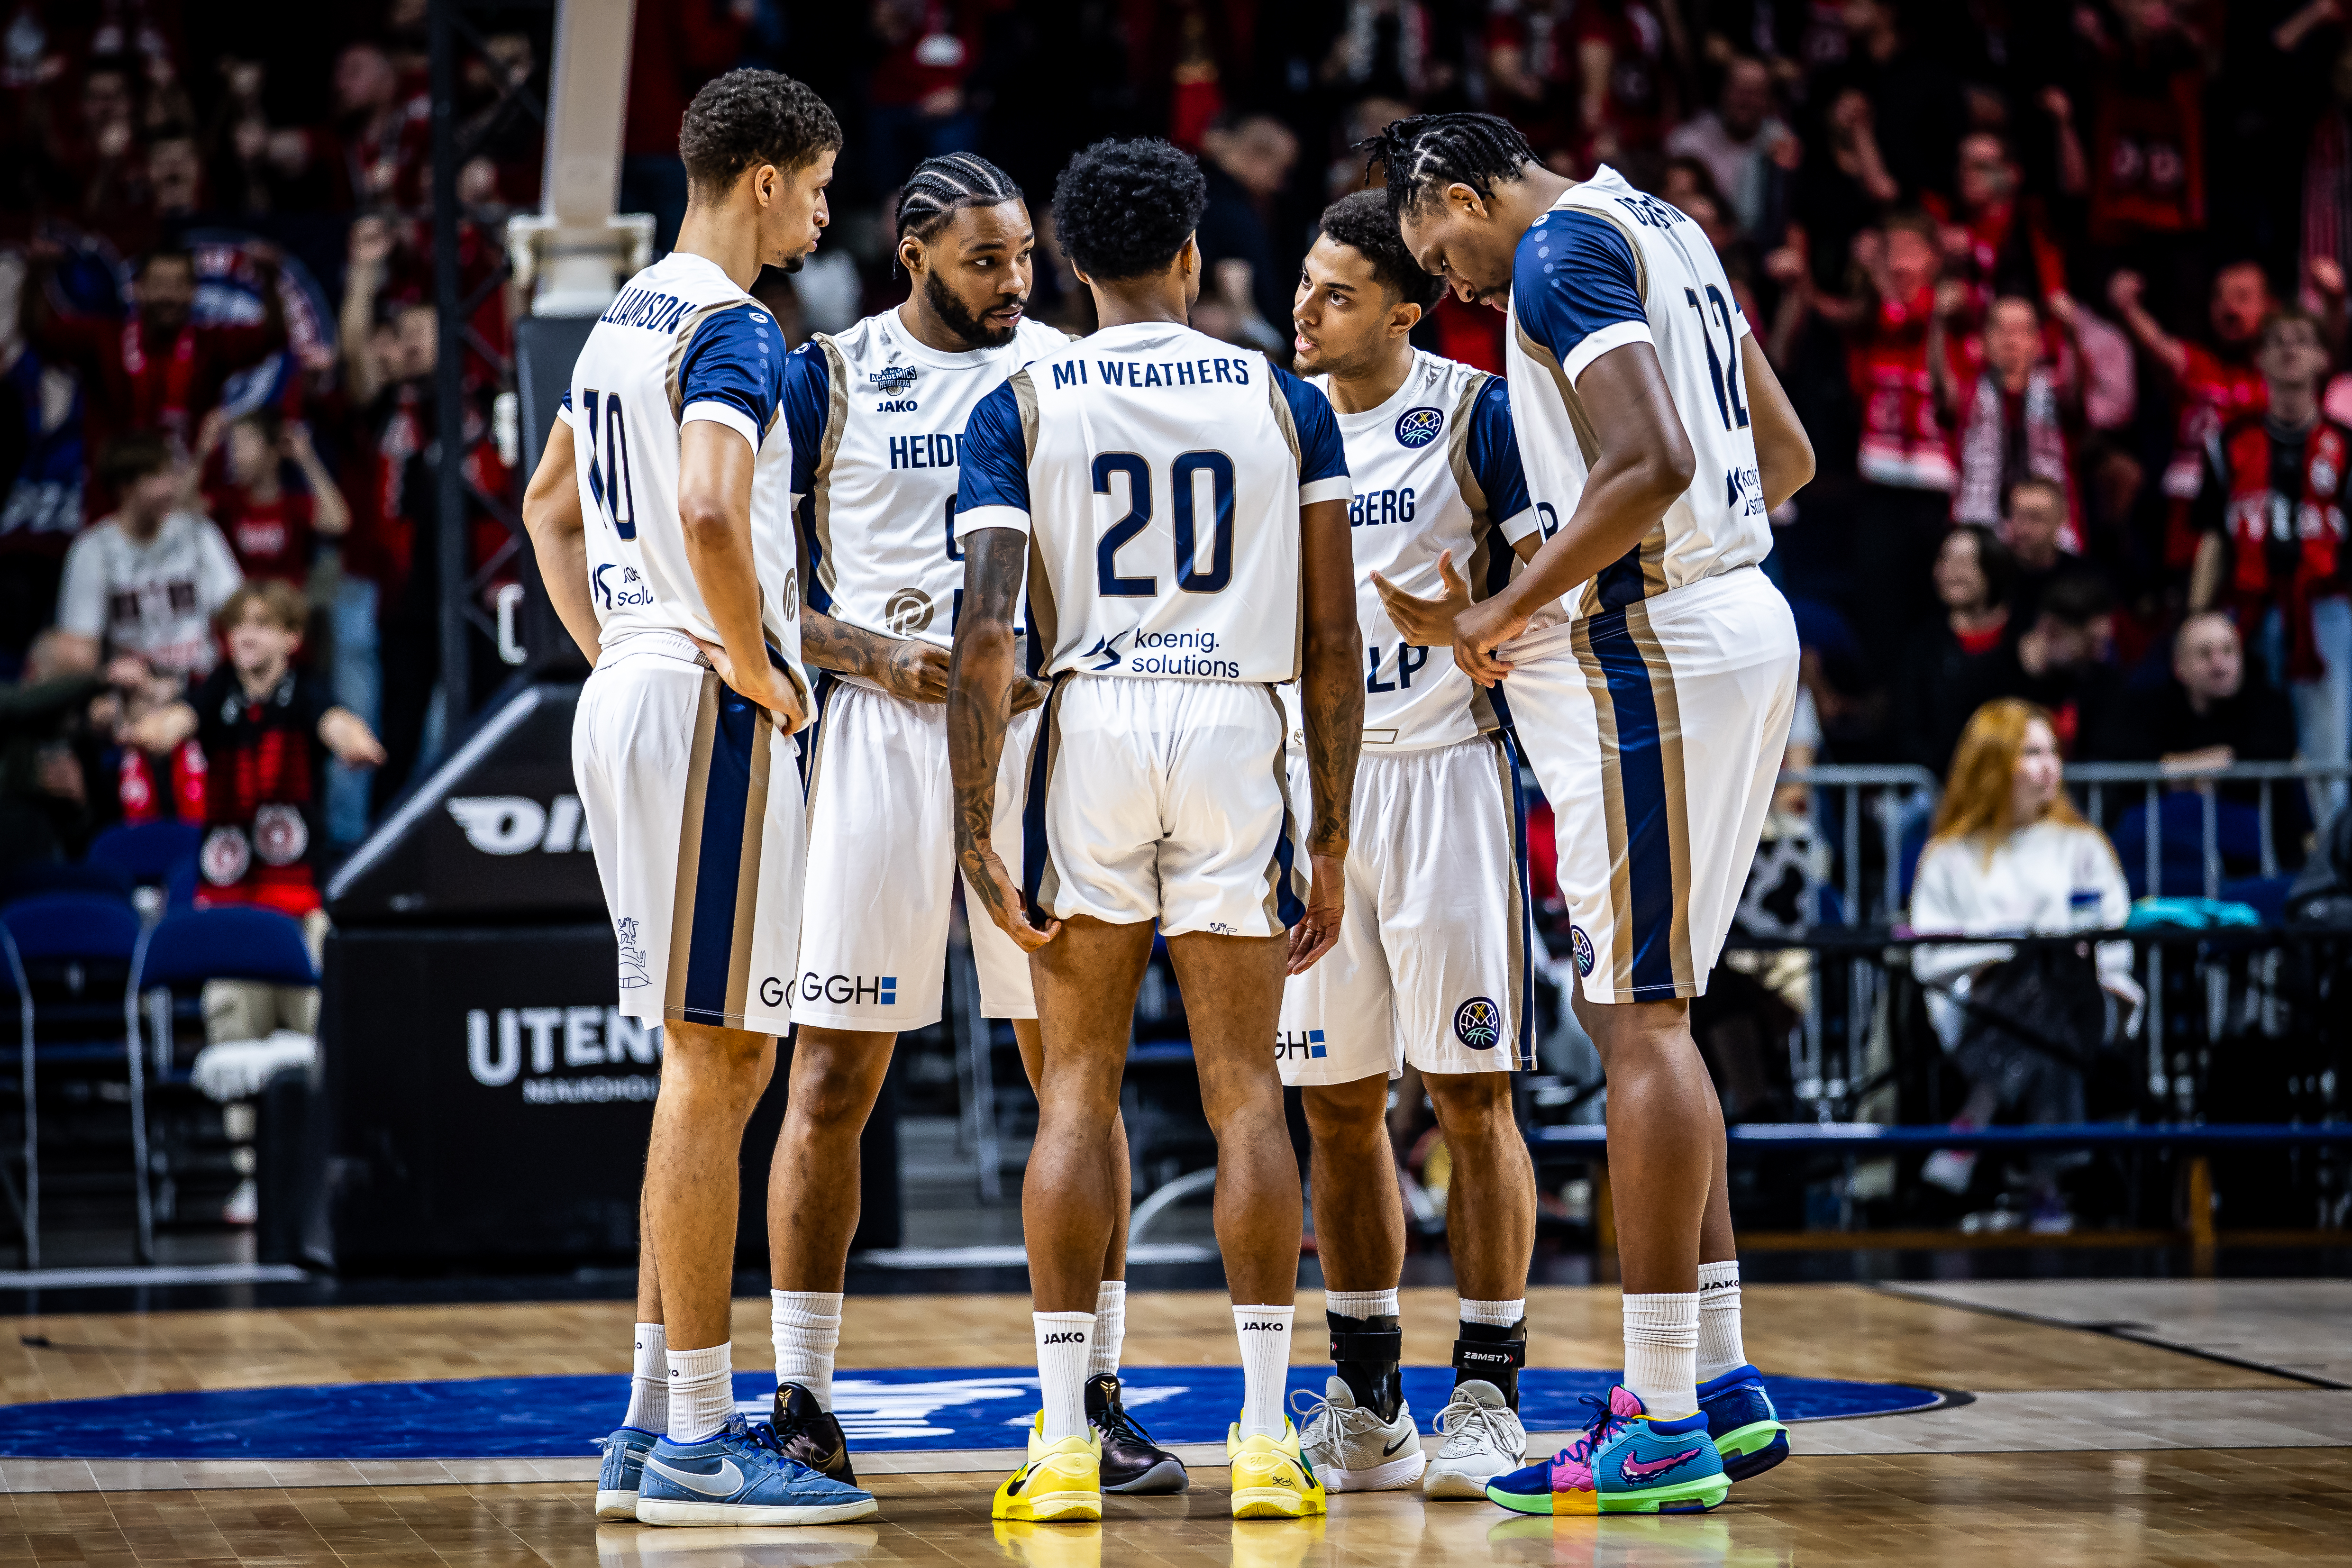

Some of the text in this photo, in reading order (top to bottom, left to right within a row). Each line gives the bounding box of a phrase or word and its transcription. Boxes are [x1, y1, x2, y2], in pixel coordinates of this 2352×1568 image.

[1684, 283, 1749, 432] 12
[871, 367, 915, 382] ACADEMICS
[879, 380, 910, 389] HEIDELBERG
[1052, 358, 1249, 390] MI WEATHERS
[877, 400, 918, 412] JAKO
[583, 388, 637, 541] 10
[1349, 487, 1415, 527] BERG
[1091, 449, 1236, 597] 20
[1134, 628, 1220, 653] koenig.
[1131, 655, 1240, 678] solutions
[802, 972, 880, 1004] GGH
[467, 1005, 663, 1087] UTEN
[1700, 1279, 1739, 1291] JAKO
[1044, 1332, 1085, 1345] JAKO
[1242, 1322, 1284, 1331] JAKO
